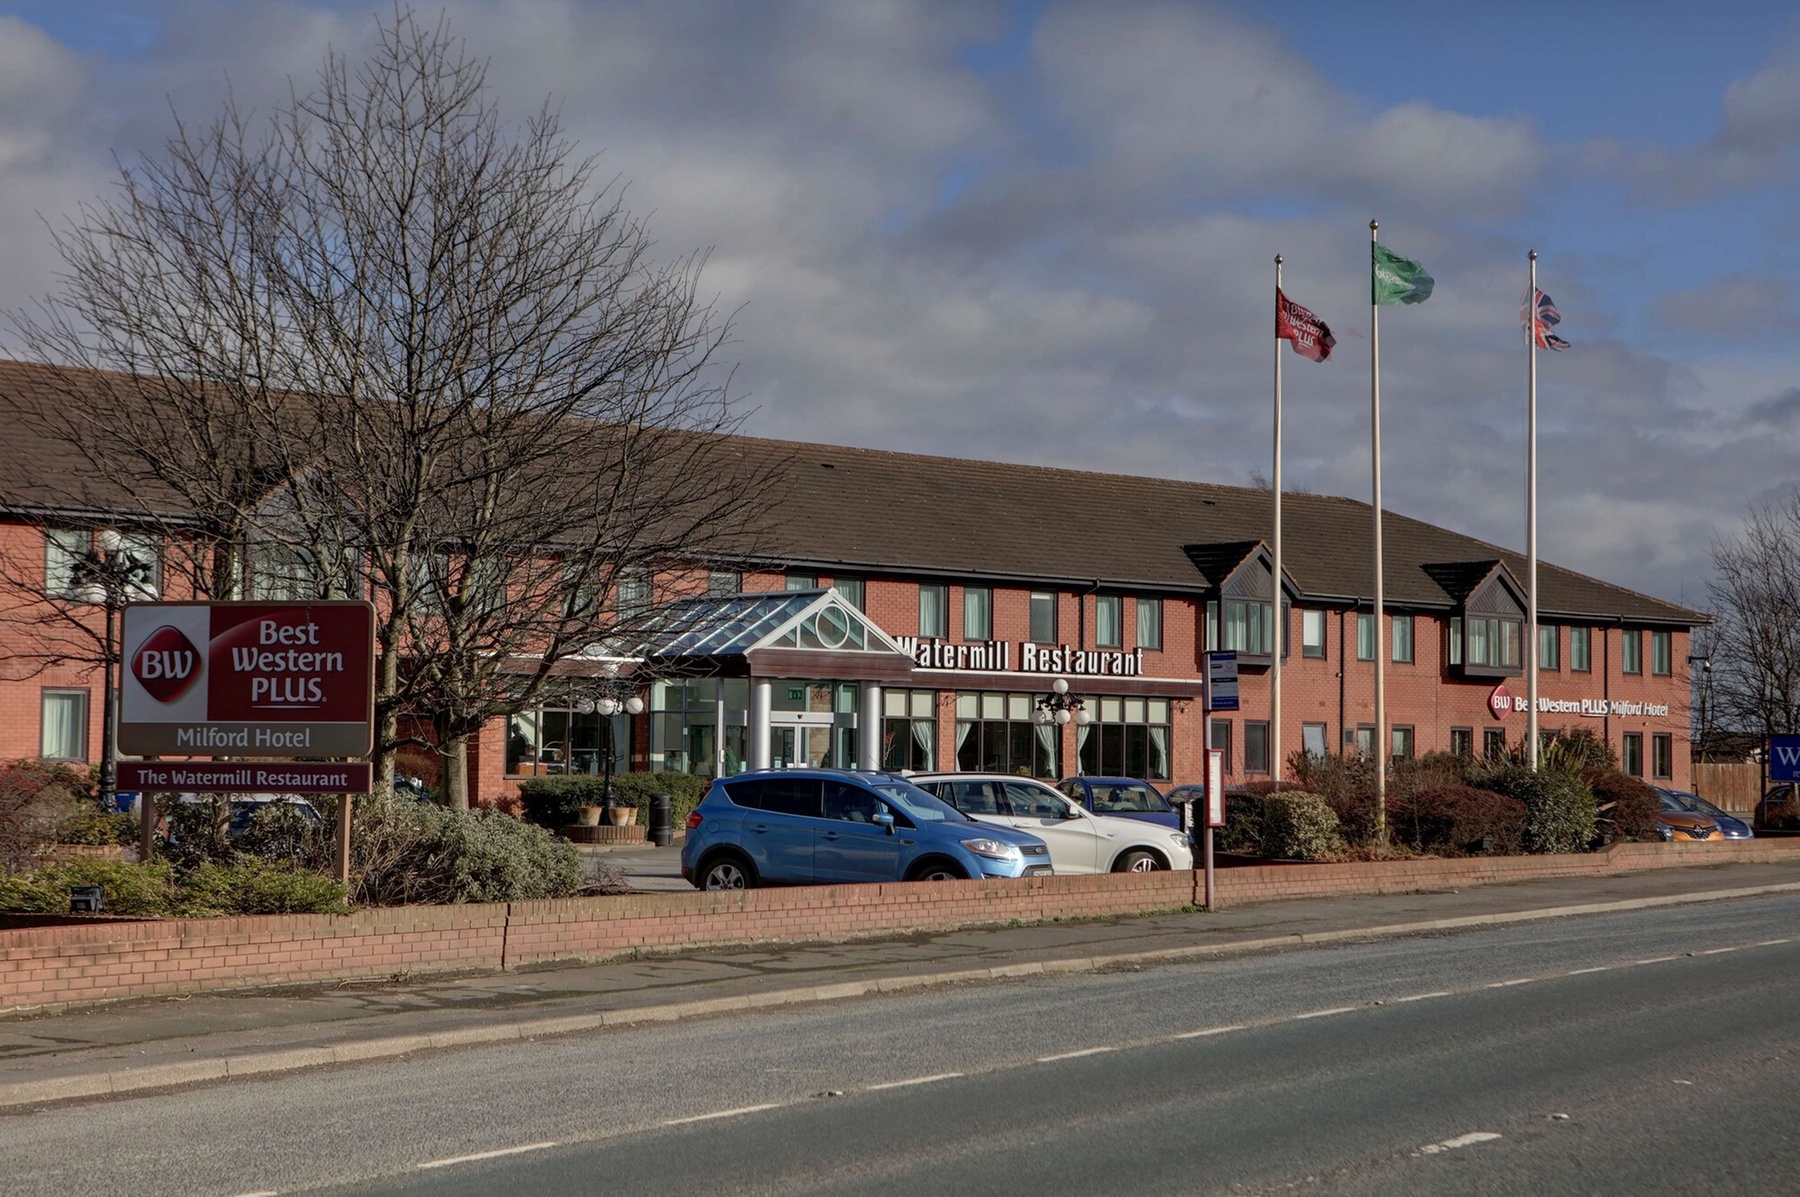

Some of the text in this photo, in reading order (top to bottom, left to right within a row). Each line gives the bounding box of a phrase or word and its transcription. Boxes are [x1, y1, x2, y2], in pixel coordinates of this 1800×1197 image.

[1290, 315, 1324, 338] Western
[259, 620, 320, 646] Best
[141, 650, 193, 680] BW
[231, 647, 344, 672] Western
[896, 636, 1144, 675] Watermill Restaurant
[251, 677, 323, 702] PLUS
[1494, 695, 1511, 709] BW
[1515, 696, 1669, 719] Be Western PLUS Milford Hotel
[177, 728, 311, 748] Milford Hotel
[137, 769, 349, 786] The Watermill Restaurant
